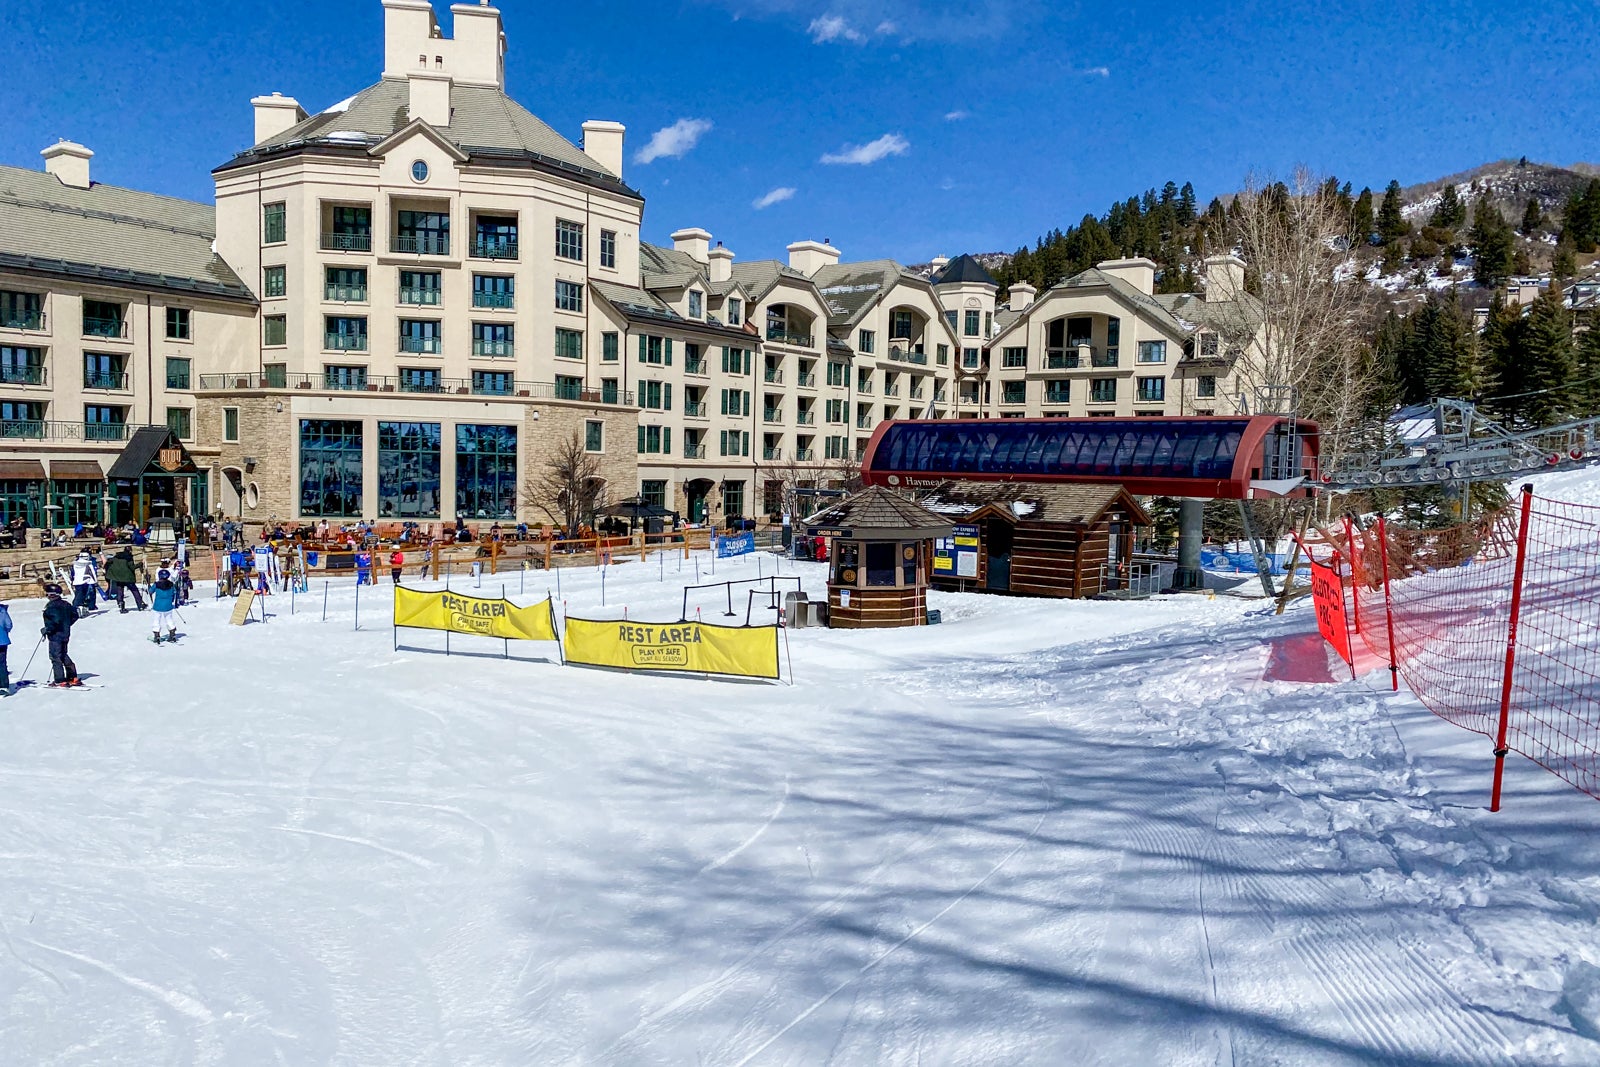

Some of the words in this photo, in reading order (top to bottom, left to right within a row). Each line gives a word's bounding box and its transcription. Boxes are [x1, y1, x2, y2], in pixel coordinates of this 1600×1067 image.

[161, 449, 181, 463] 8100
[905, 476, 945, 487] Haymead
[725, 538, 747, 549] CLOSED
[442, 595, 469, 613] REST
[472, 602, 506, 617] AREA
[619, 625, 654, 643] REST
[660, 627, 702, 643] AREA
